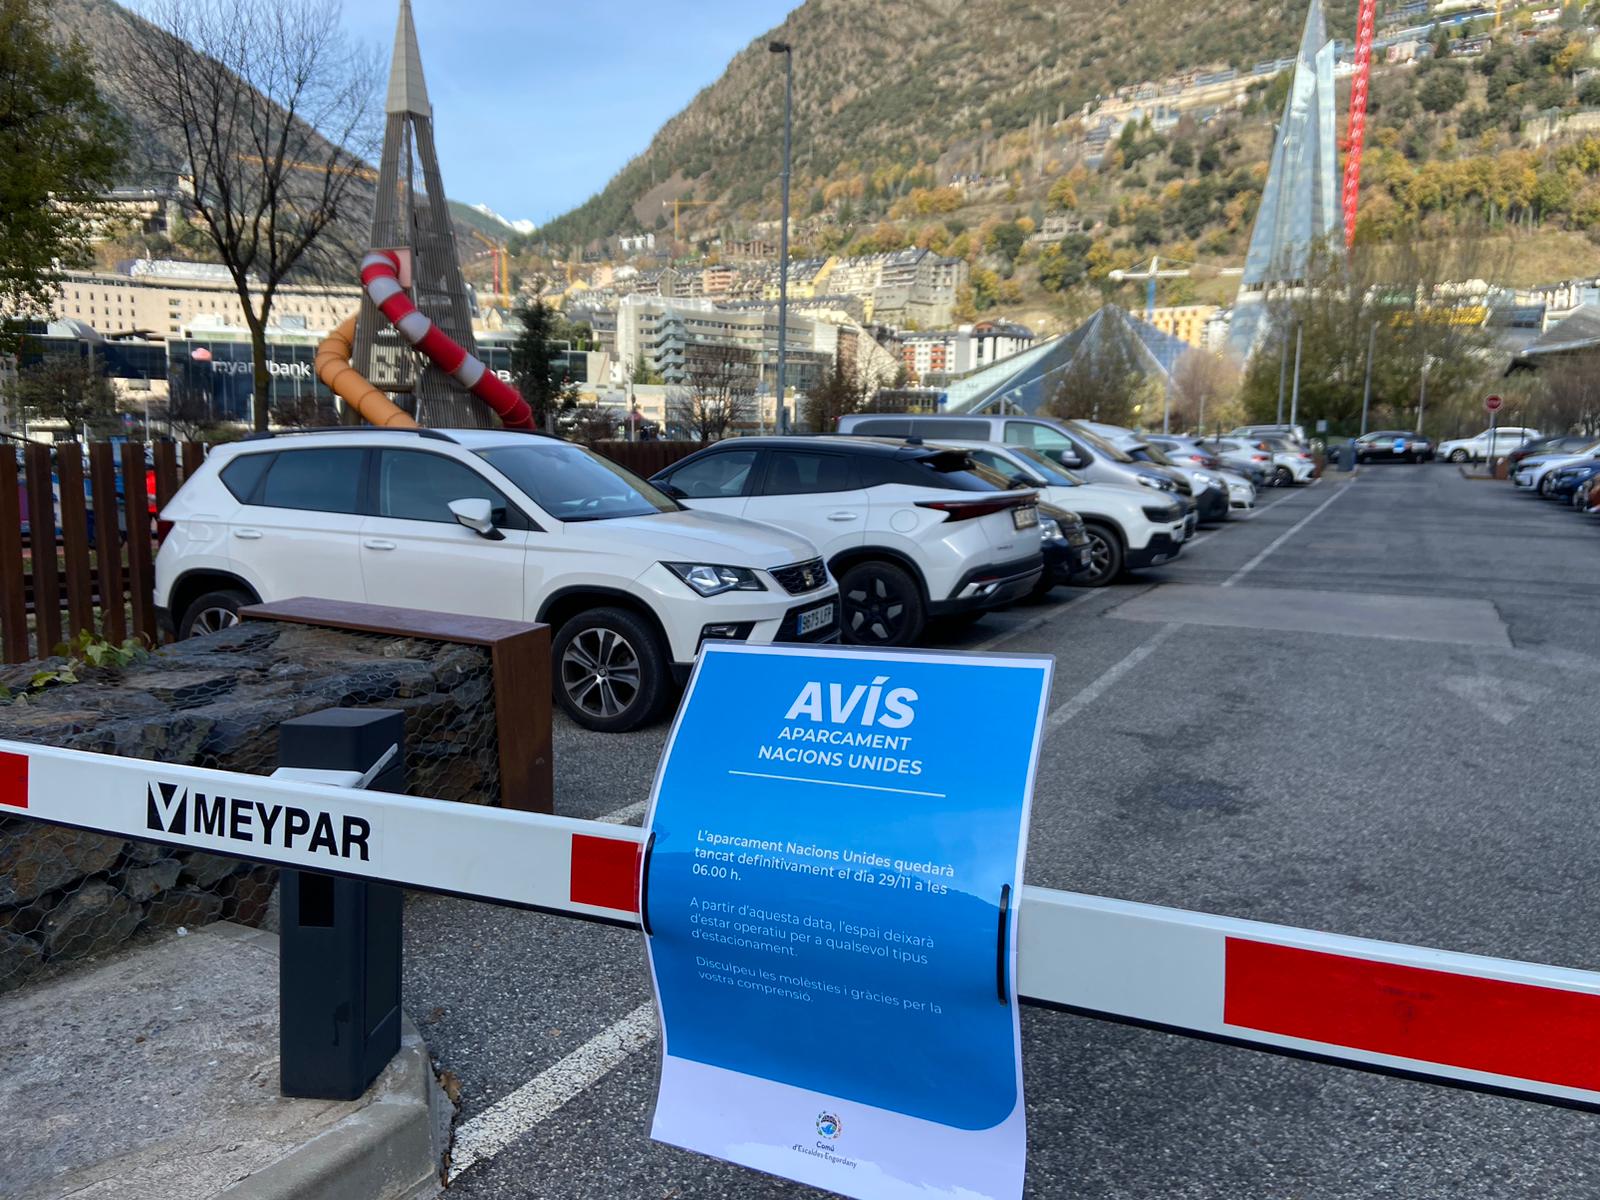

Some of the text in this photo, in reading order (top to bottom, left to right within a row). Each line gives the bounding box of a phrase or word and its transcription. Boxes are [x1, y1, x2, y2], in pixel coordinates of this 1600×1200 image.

[784, 676, 918, 728] AVÍS
[758, 745, 922, 775] NACIONS UNIDES
[778, 726, 912, 750] APARCAMENT
[194, 793, 370, 862] MEYPAR
[692, 863, 742, 880] 06.00 h.
[694, 846, 948, 894] tancat definitivament el dia 29/11 a les
[697, 829, 954, 877] L'aparcament Nacions Unides quedarà
[690, 896, 934, 948] A partir d'aquesta data, l'espai deixarà
[690, 914, 928, 964] d'estar operatiu per a qualsevol tipus
[691, 928, 798, 957] d'estacionament.
[696, 956, 756, 977] Disculpeu
[759, 968, 777, 981] les
[844, 984, 848, 996] i
[851, 988, 900, 1006] gràcies
[903, 998, 926, 1010] per
[930, 1002, 942, 1014] la
[698, 970, 814, 1002] vostra comprensió.
[816, 1140, 835, 1152] Comú
